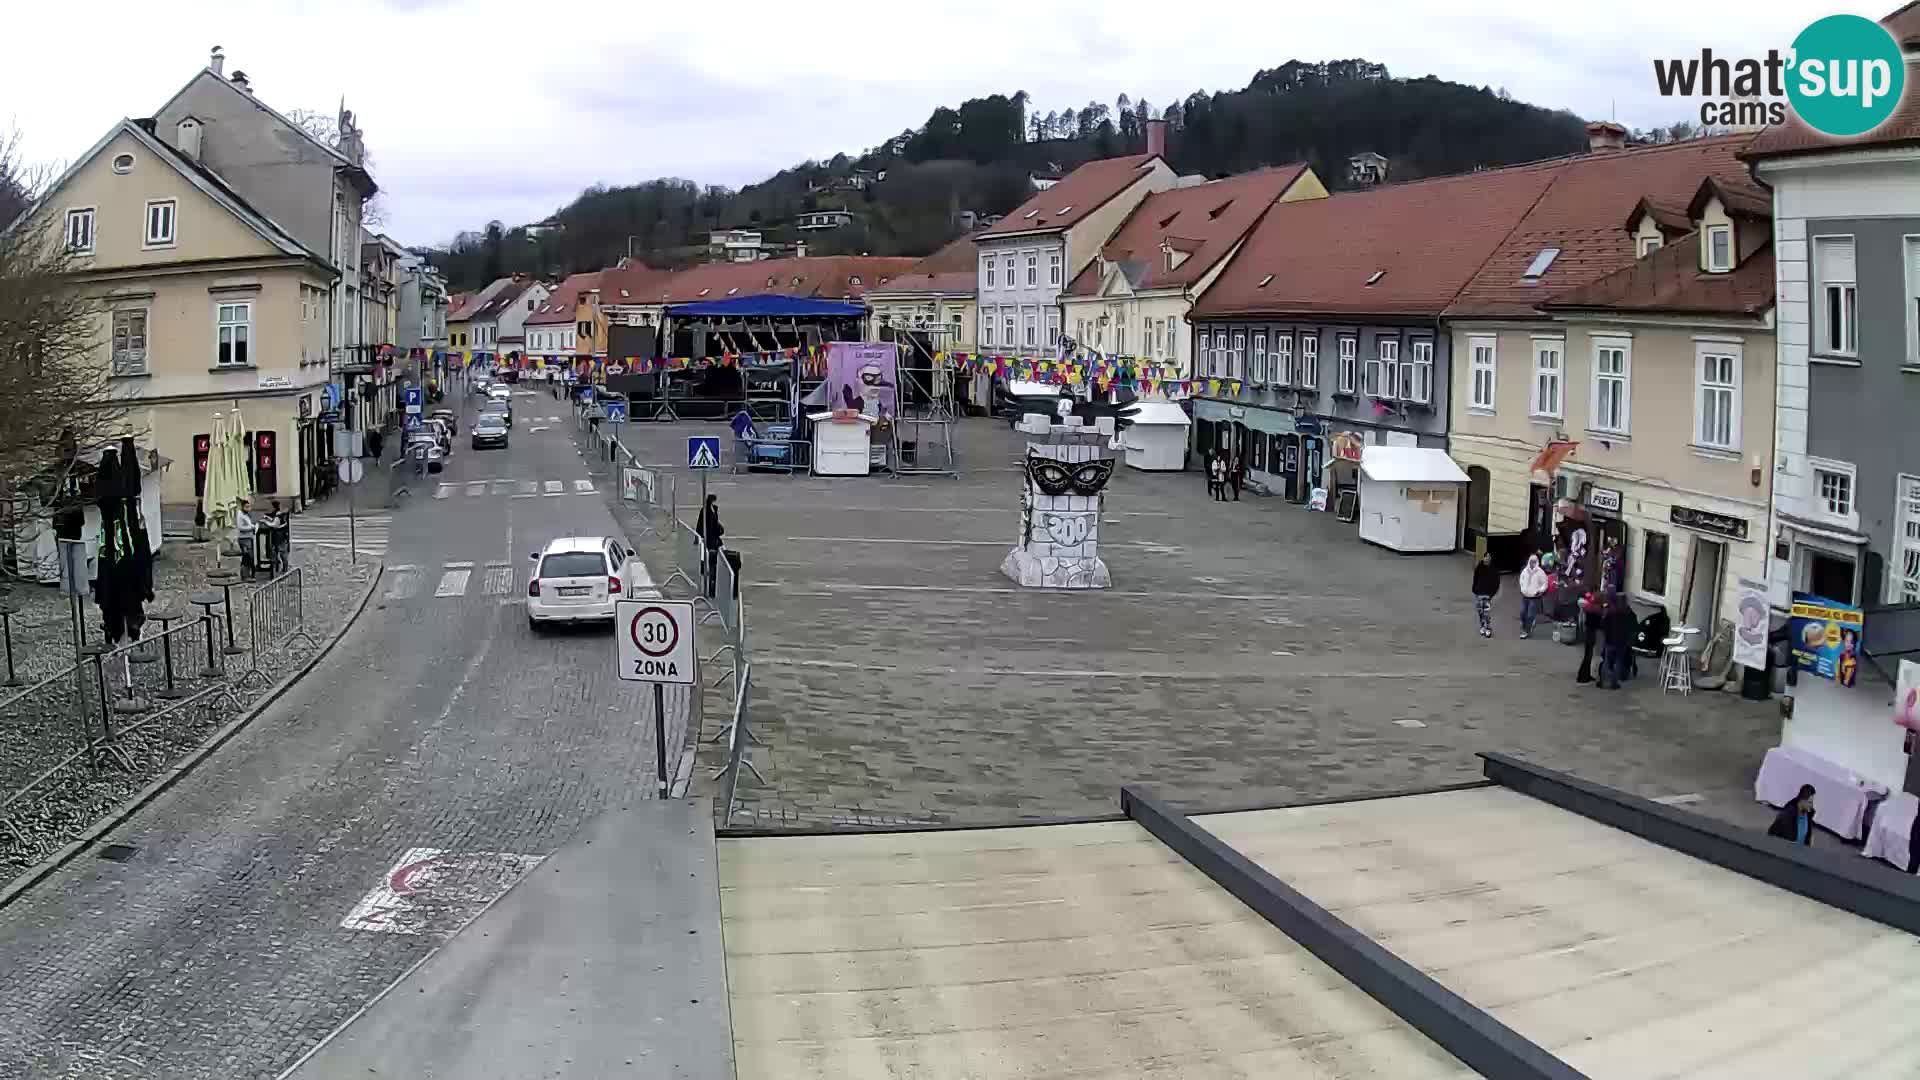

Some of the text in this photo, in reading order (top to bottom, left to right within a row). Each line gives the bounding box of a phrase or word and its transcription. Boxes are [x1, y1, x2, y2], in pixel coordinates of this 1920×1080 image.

[409, 391, 416, 403] P
[1047, 516, 1087, 546] 200
[643, 622, 668, 644] 30
[634, 659, 678, 677] ZONA
